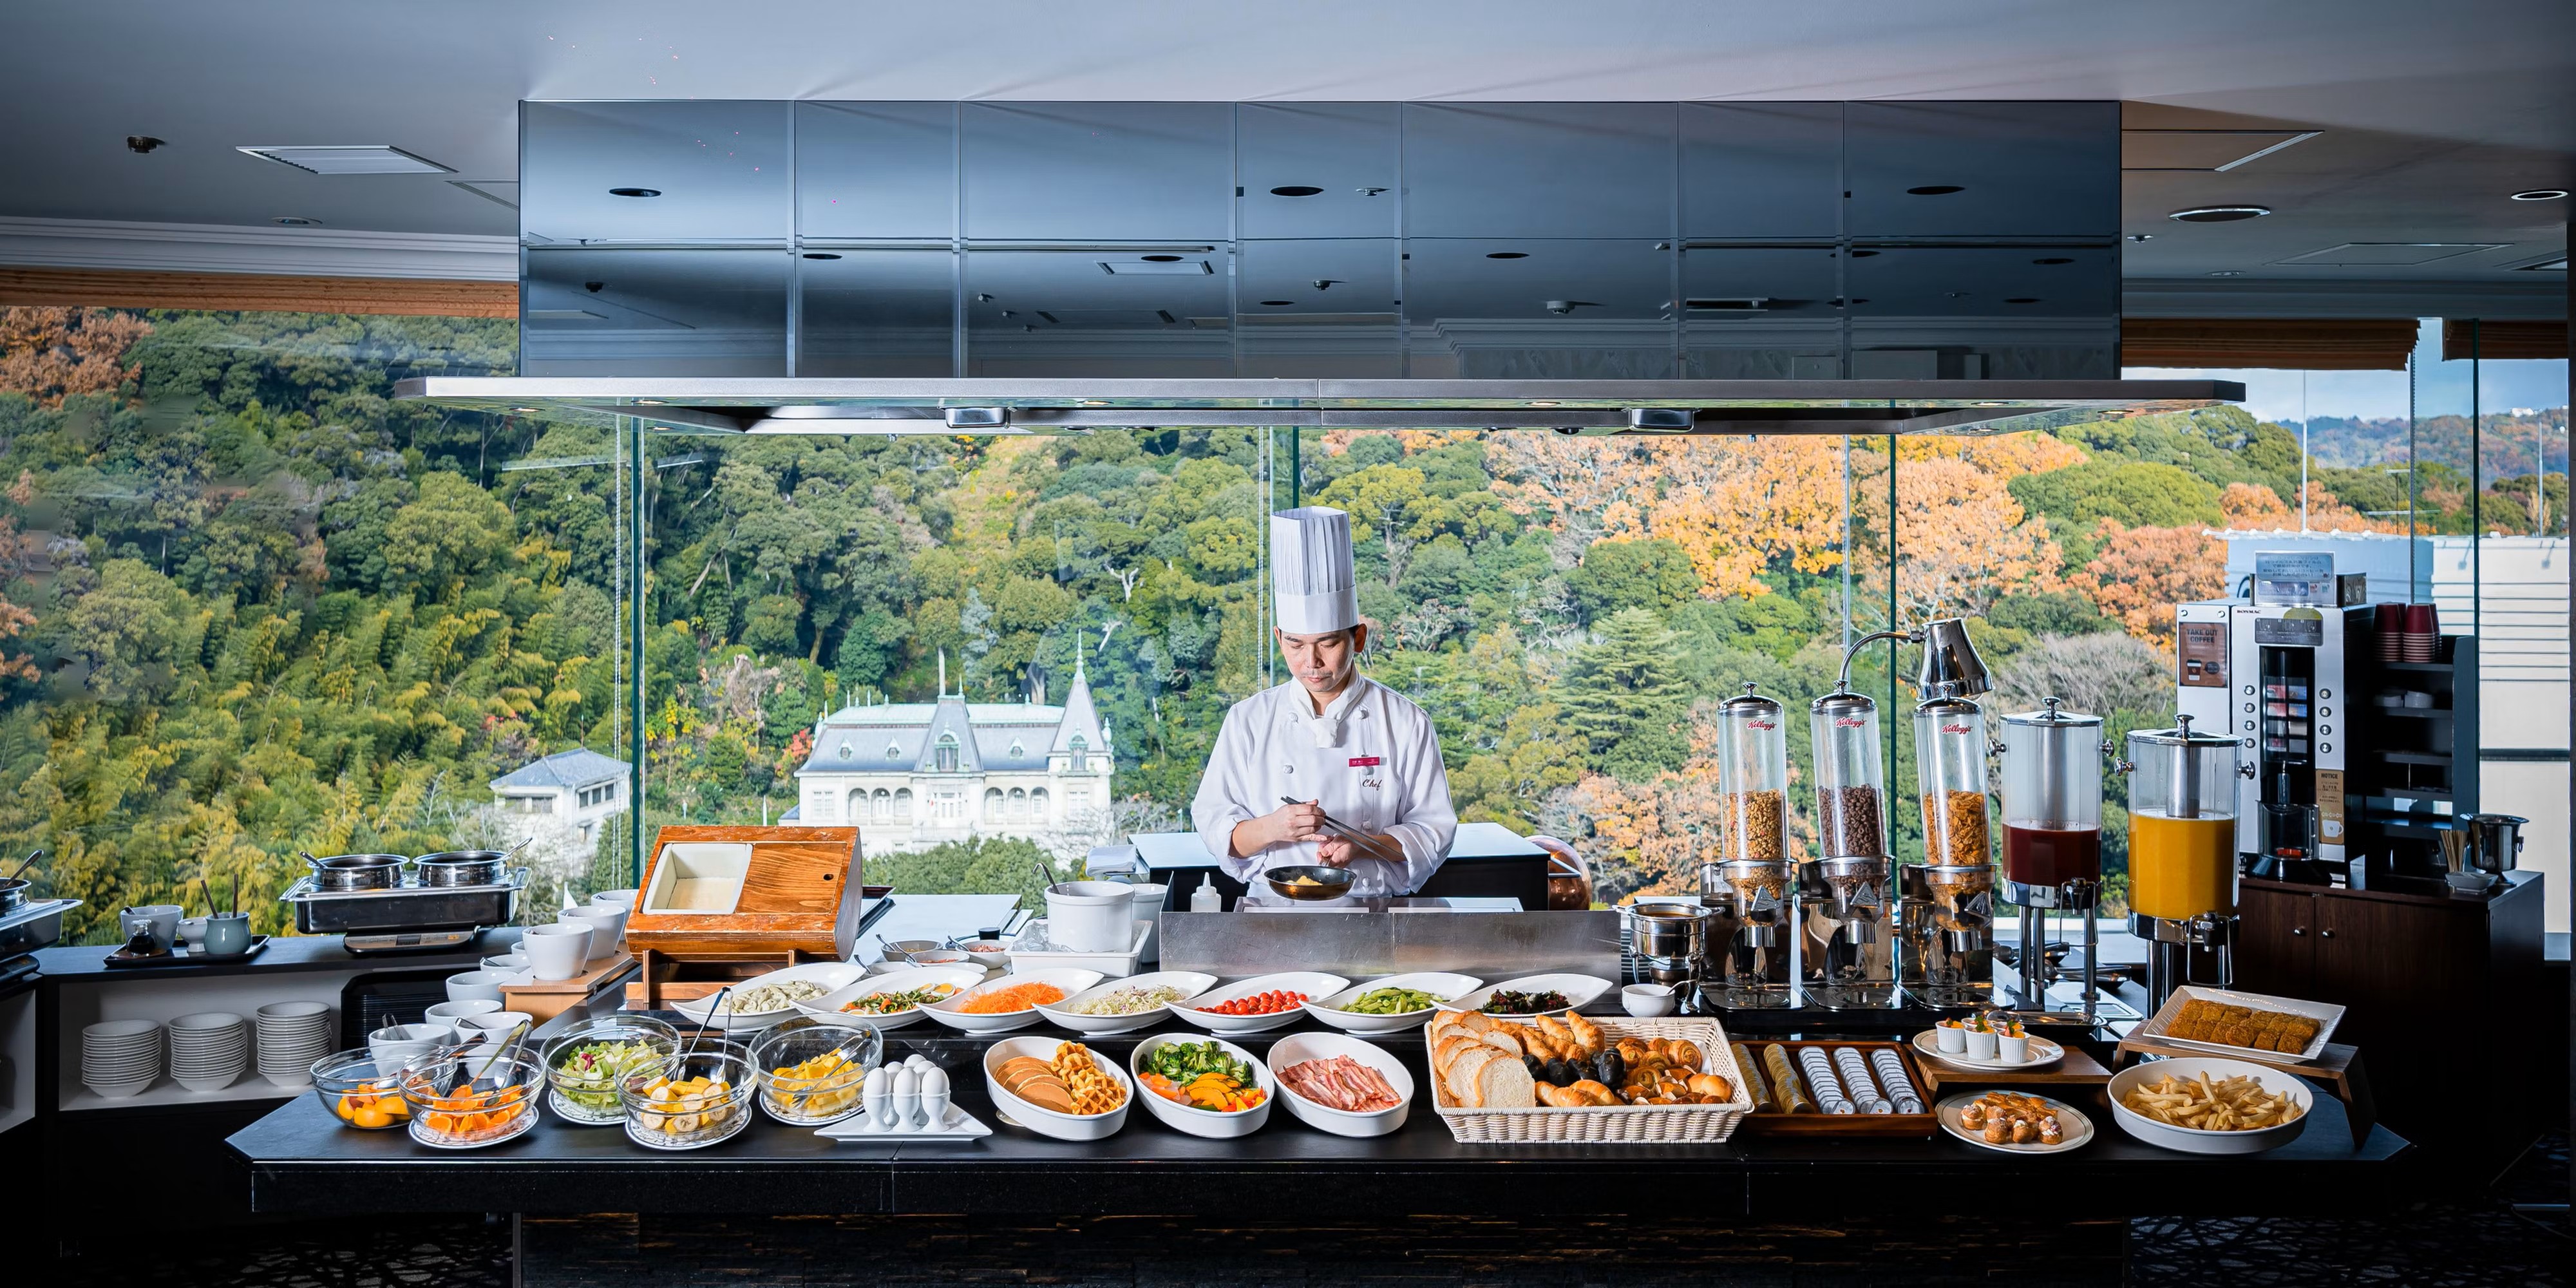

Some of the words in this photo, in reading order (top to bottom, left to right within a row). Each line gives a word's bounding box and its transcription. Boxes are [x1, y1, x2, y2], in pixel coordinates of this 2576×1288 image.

[1748, 720, 1776, 730] Kellogg's
[1836, 717, 1866, 728] Kellogg's
[1942, 724, 1972, 734] Kellogg's
[1362, 779, 1382, 791] Chef
